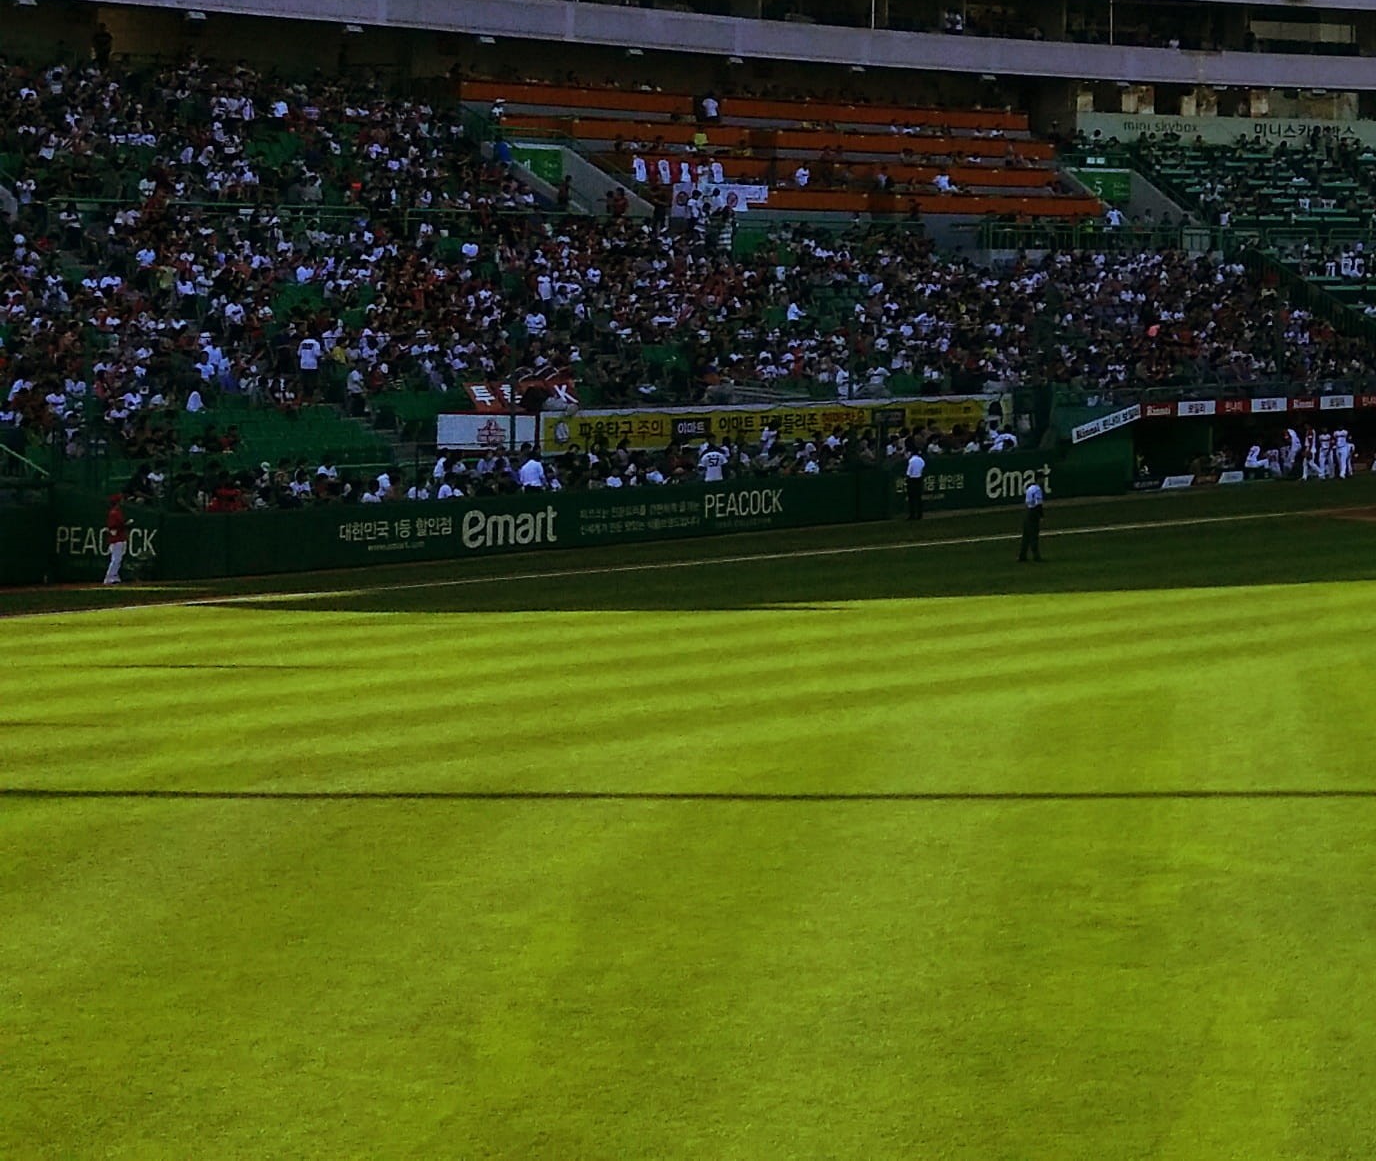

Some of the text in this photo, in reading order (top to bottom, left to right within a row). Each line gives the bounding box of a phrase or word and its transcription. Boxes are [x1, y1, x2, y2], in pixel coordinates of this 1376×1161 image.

[1123, 120, 1198, 133] mini skybox
[1254, 122, 1355, 141] 미니스카박스
[636, 420, 663, 437] 주의
[677, 421, 705, 434] 이마트
[719, 416, 754, 432] 이마트
[760, 412, 818, 434] 프들리존
[705, 489, 784, 518] PEACOCK
[338, 516, 452, 542] 대한민국 1등 할인점
[462, 505, 558, 549] emart
[56, 526, 158, 557] PEACCK
